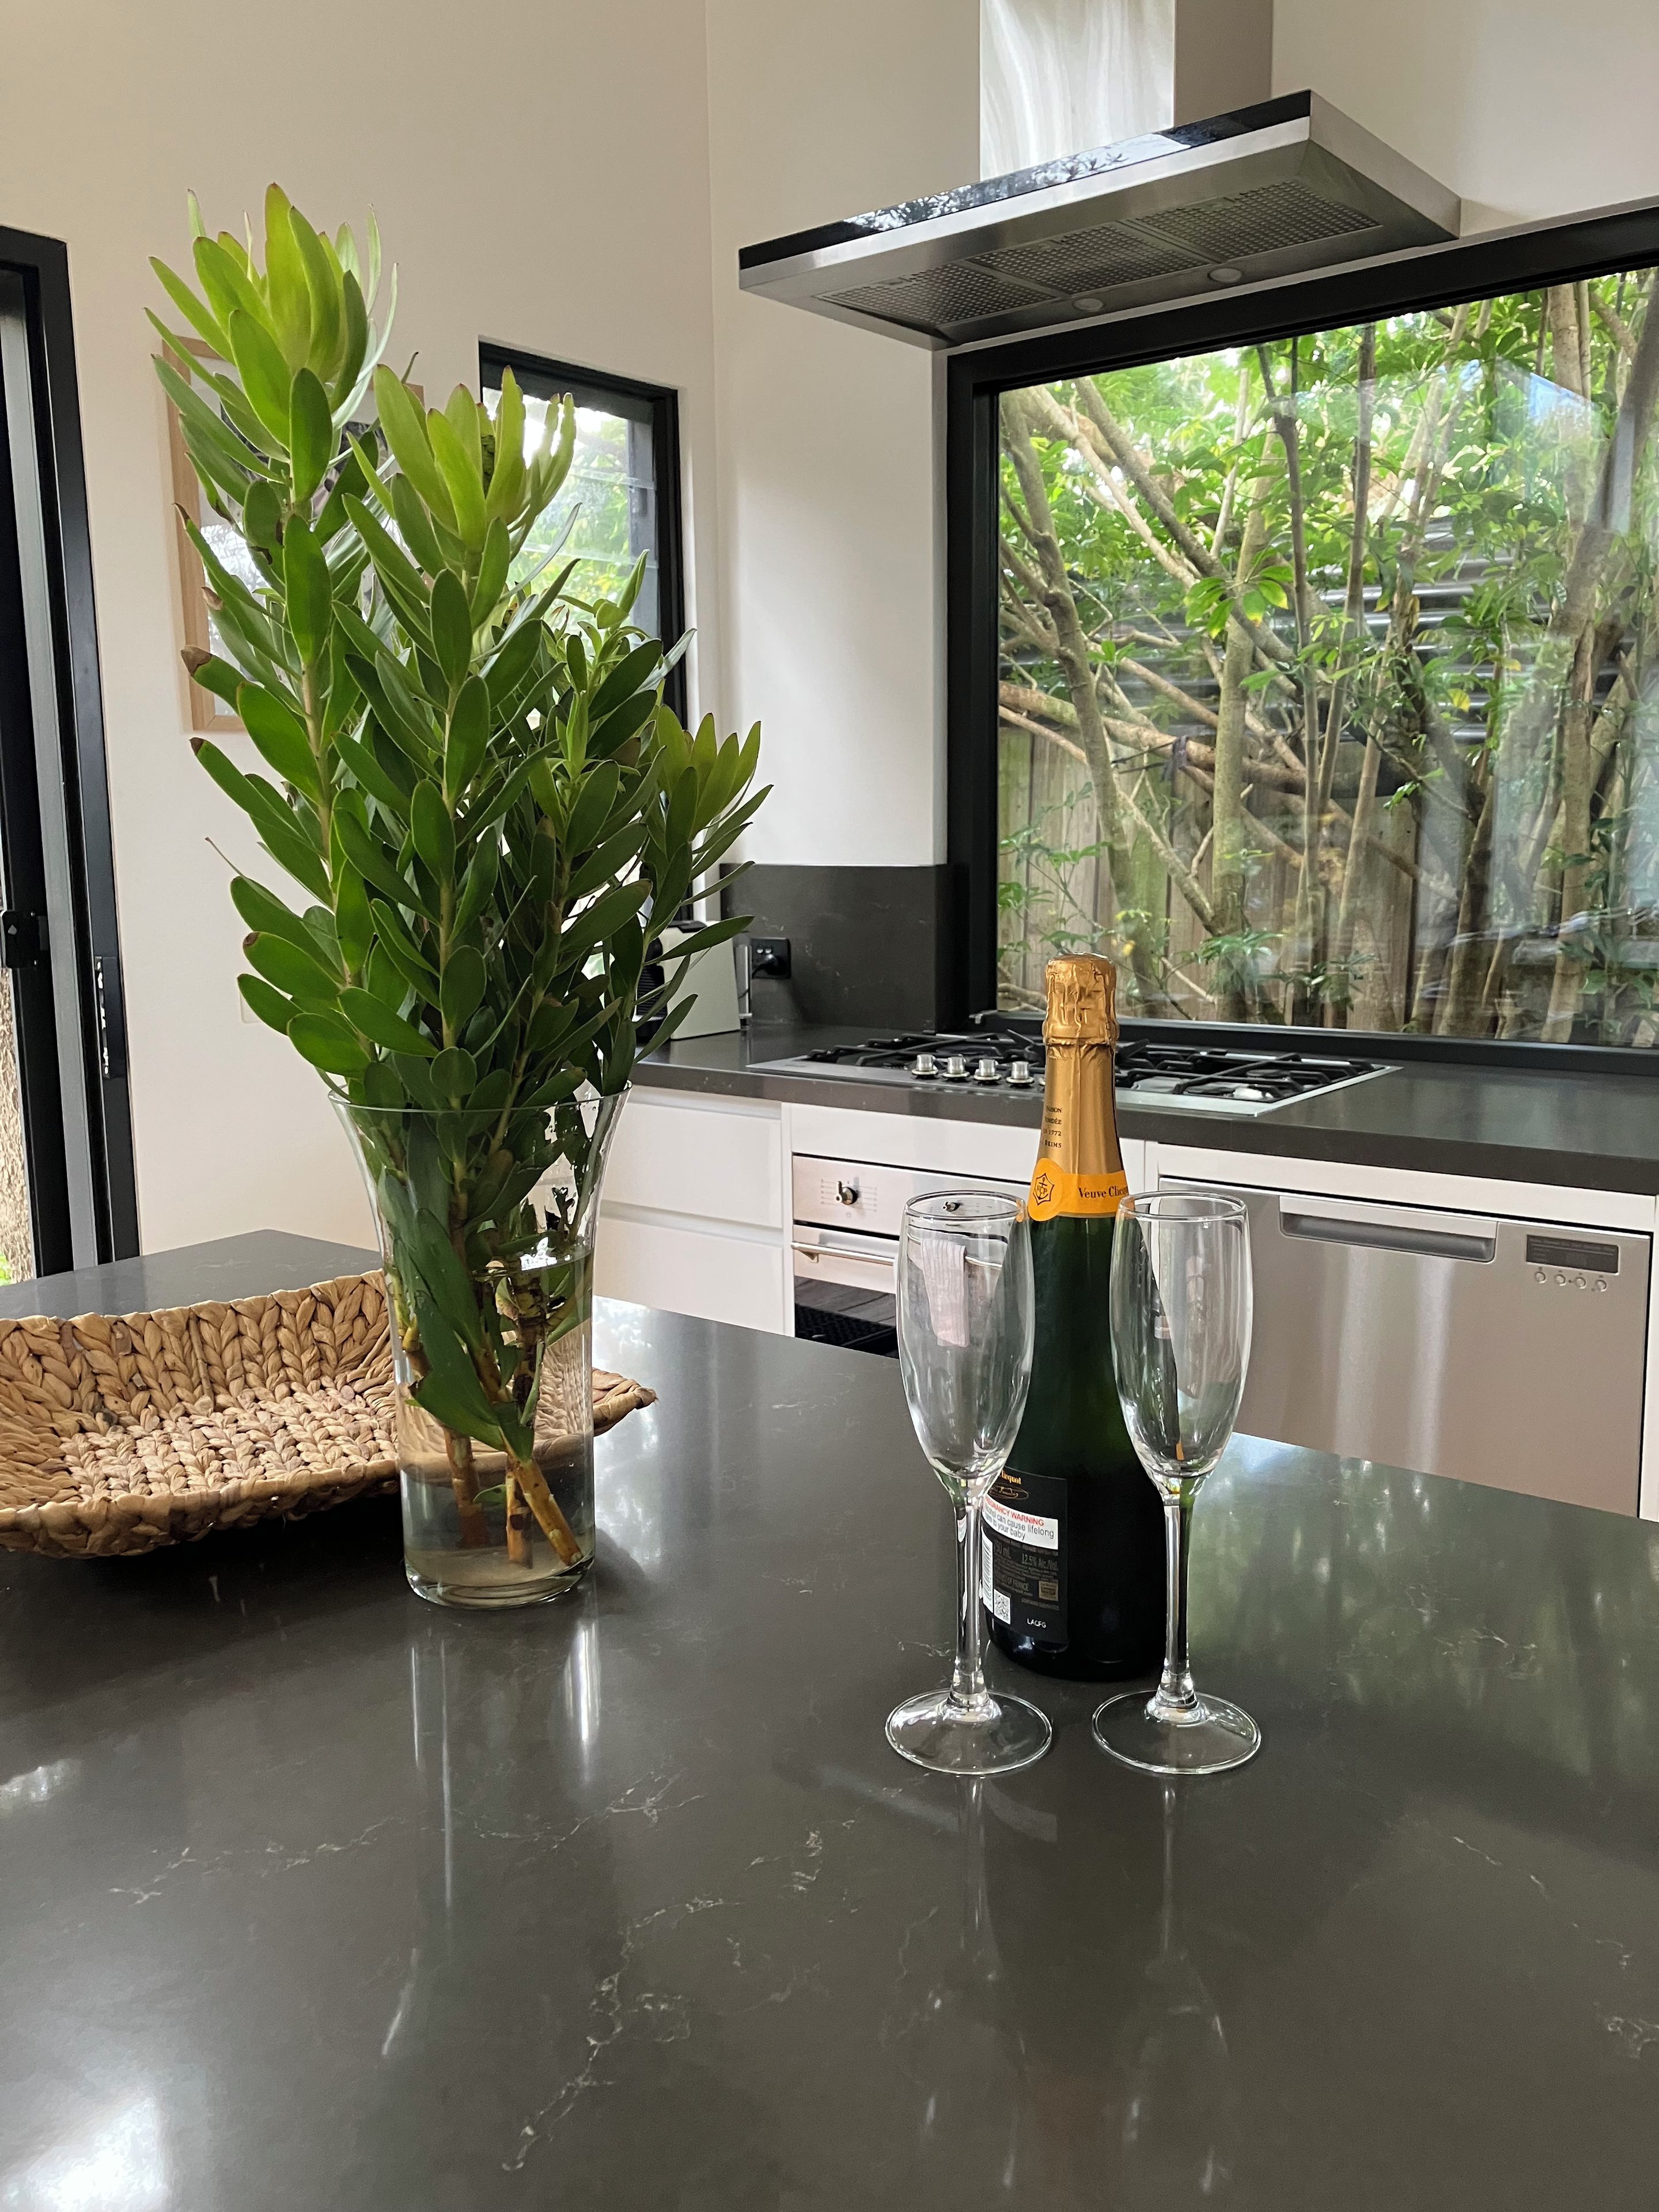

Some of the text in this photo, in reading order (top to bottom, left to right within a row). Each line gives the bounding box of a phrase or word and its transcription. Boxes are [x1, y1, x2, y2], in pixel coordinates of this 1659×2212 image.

[1078, 1187, 1107, 1198] Veuve
[1001, 1469, 1021, 1484] licquot
[1011, 1511, 1044, 1526] WARNING
[997, 1514, 1006, 1524] can
[1007, 1520, 1025, 1531] cause
[1028, 1524, 1054, 1539] lifelong
[998, 1522, 1009, 1532] your
[1010, 1528, 1025, 1541] baby
[1021, 1553, 1037, 1567] 12.5%
